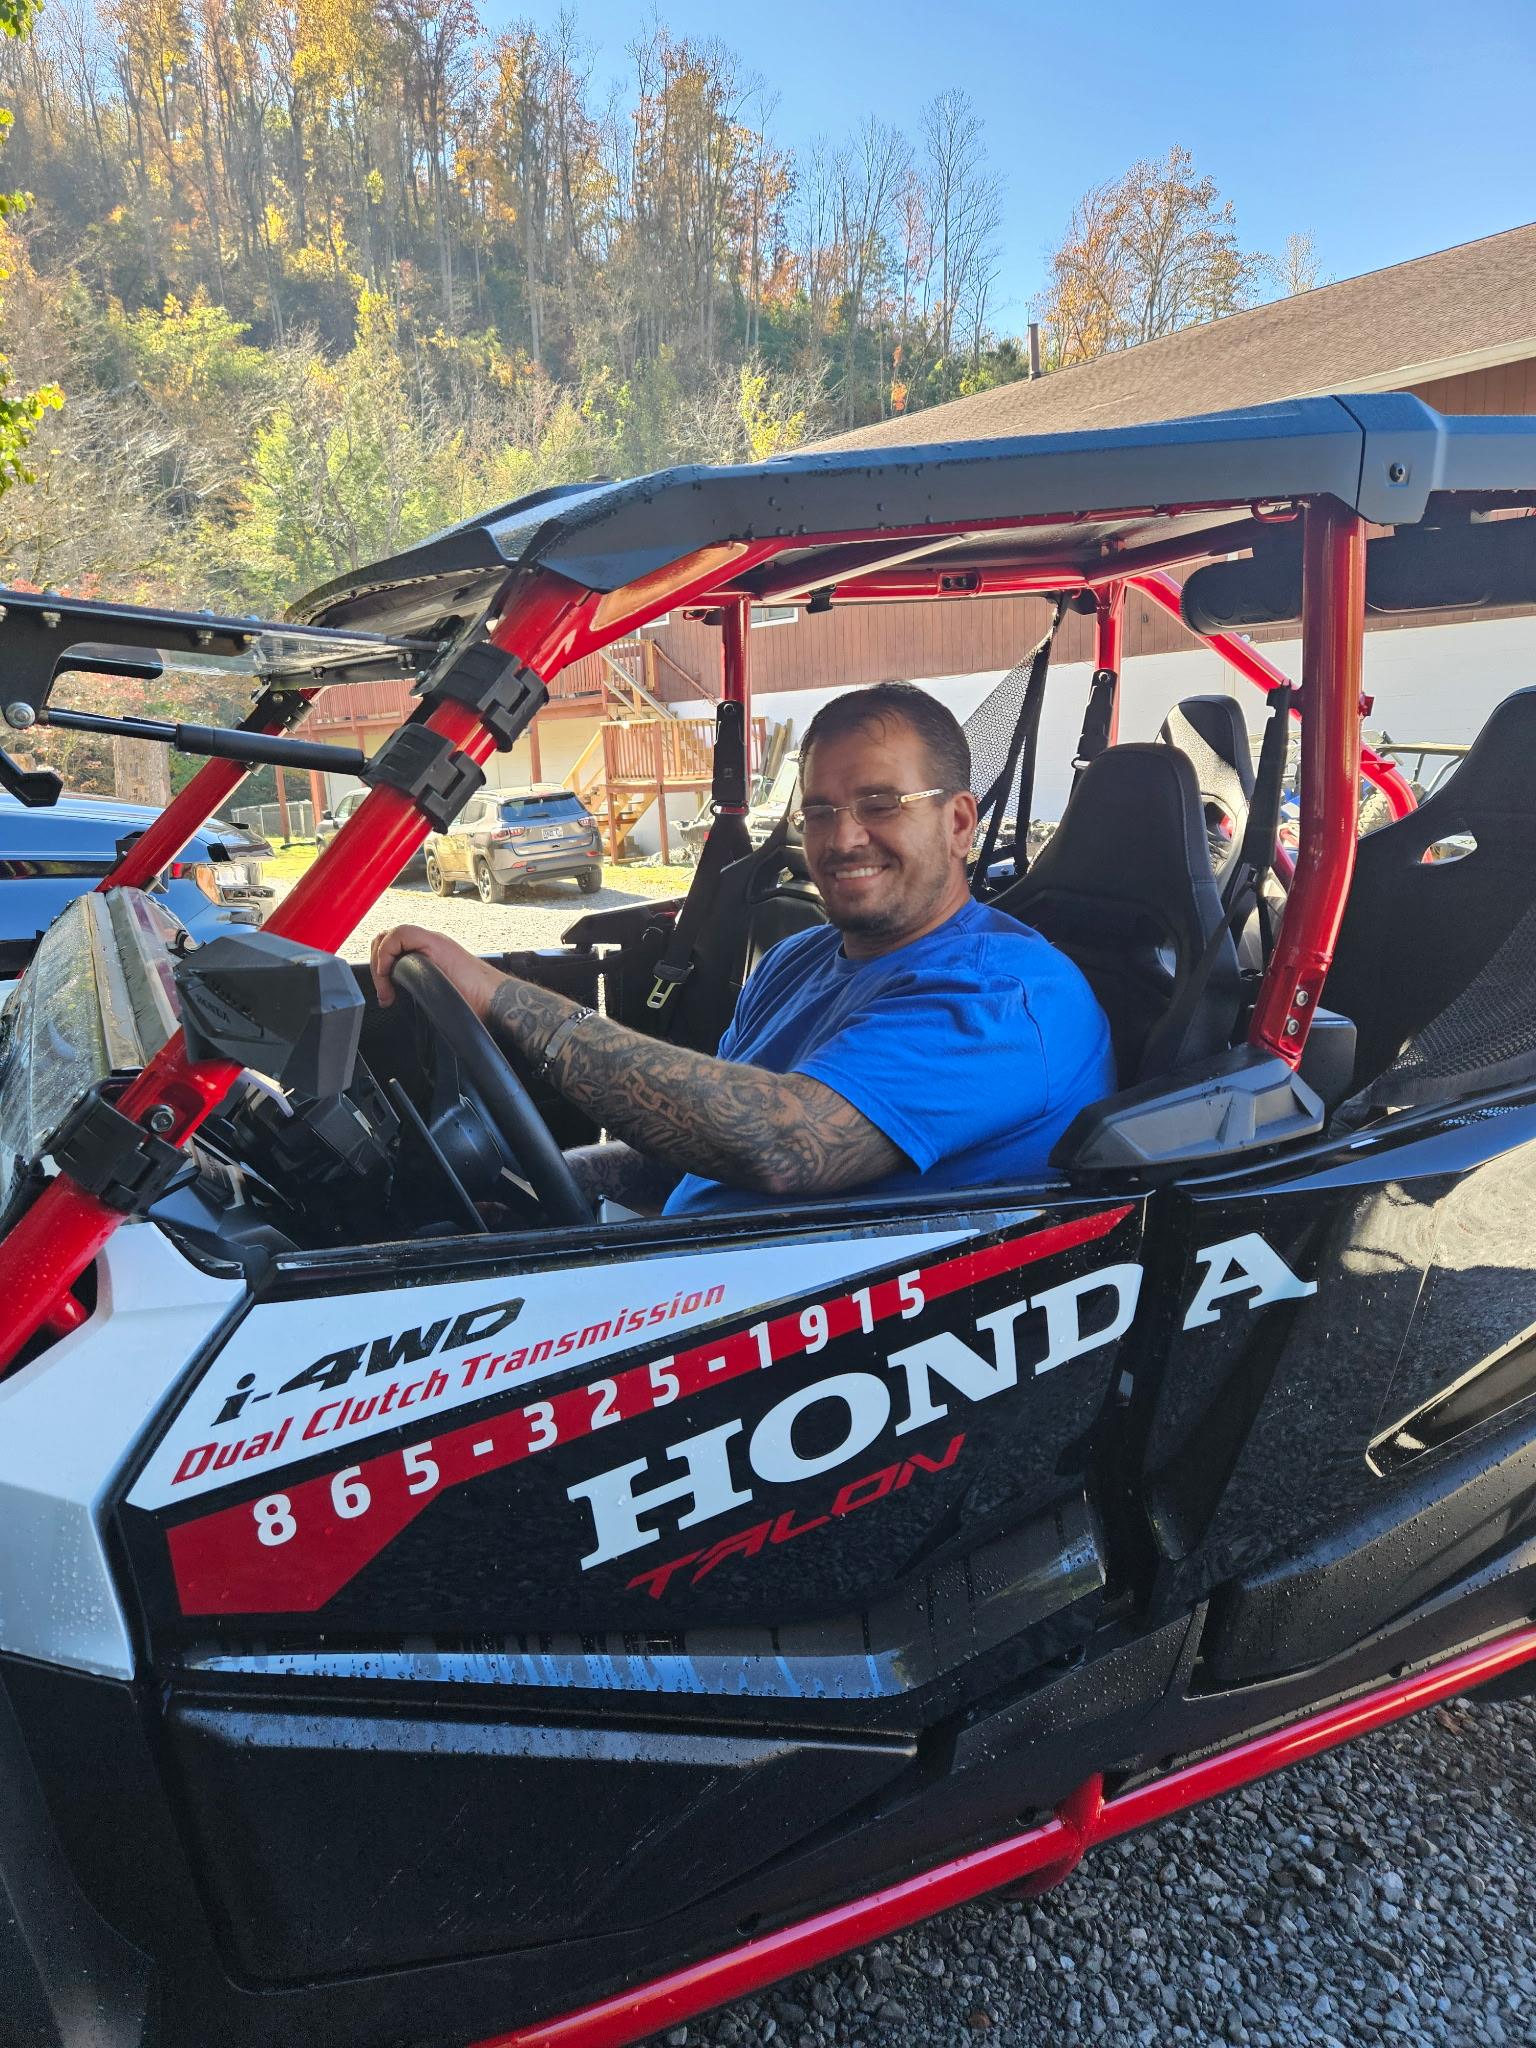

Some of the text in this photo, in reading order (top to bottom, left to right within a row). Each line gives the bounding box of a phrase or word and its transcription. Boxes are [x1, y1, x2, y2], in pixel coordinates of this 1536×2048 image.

[171, 1284, 725, 1486] Dual Clutch Transmission
[211, 1297, 525, 1427] i-4WD
[567, 1232, 1318, 1571] HONDA
[625, 1433, 966, 1600] TALON
